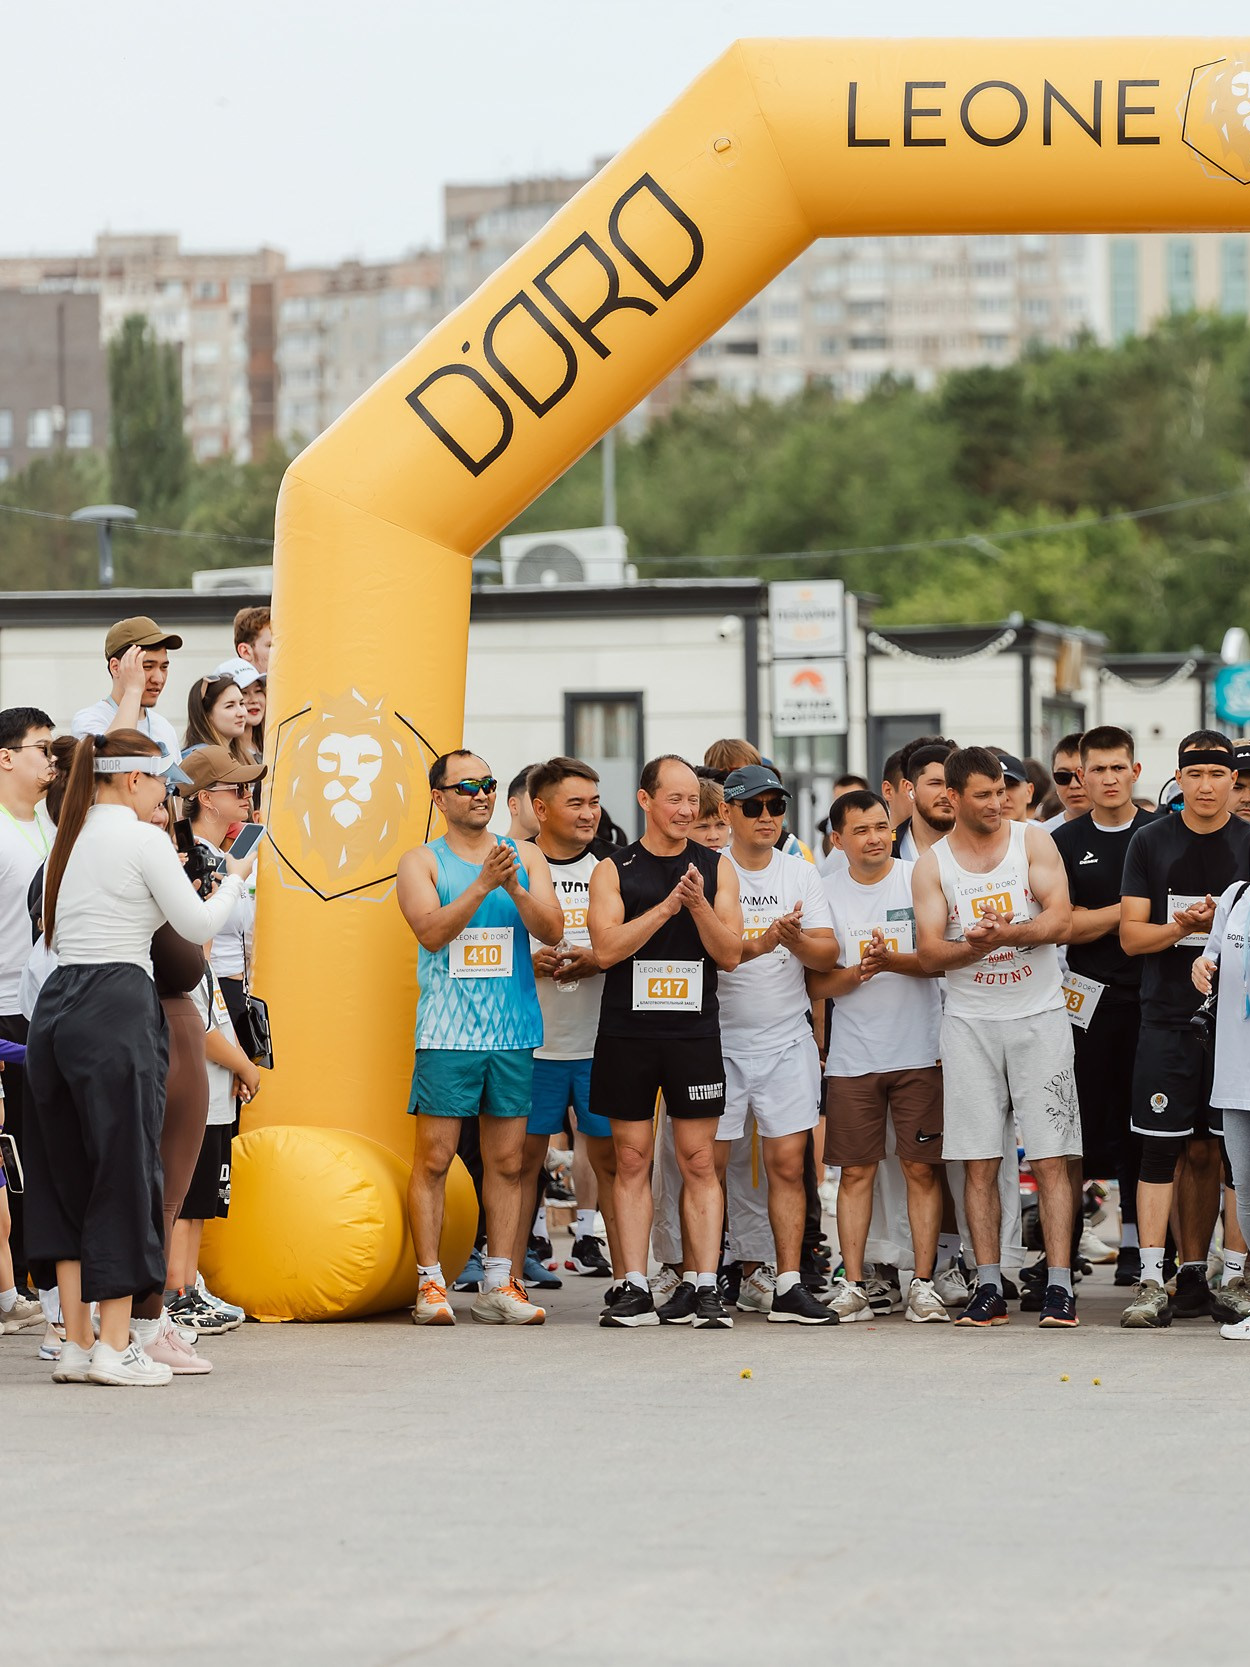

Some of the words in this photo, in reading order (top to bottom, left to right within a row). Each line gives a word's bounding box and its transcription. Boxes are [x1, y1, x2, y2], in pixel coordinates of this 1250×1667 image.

[847, 78, 1160, 148] LEONE
[405, 172, 704, 478] D'ORO
[101, 759, 121, 771] DIOR
[960, 886, 984, 896] LEONE
[563, 910, 586, 927] 35
[467, 947, 499, 964] 410
[988, 950, 1014, 964] AGAIN
[639, 966, 664, 974] LEONE
[973, 964, 1034, 986] ROUND
[651, 980, 685, 996] 417
